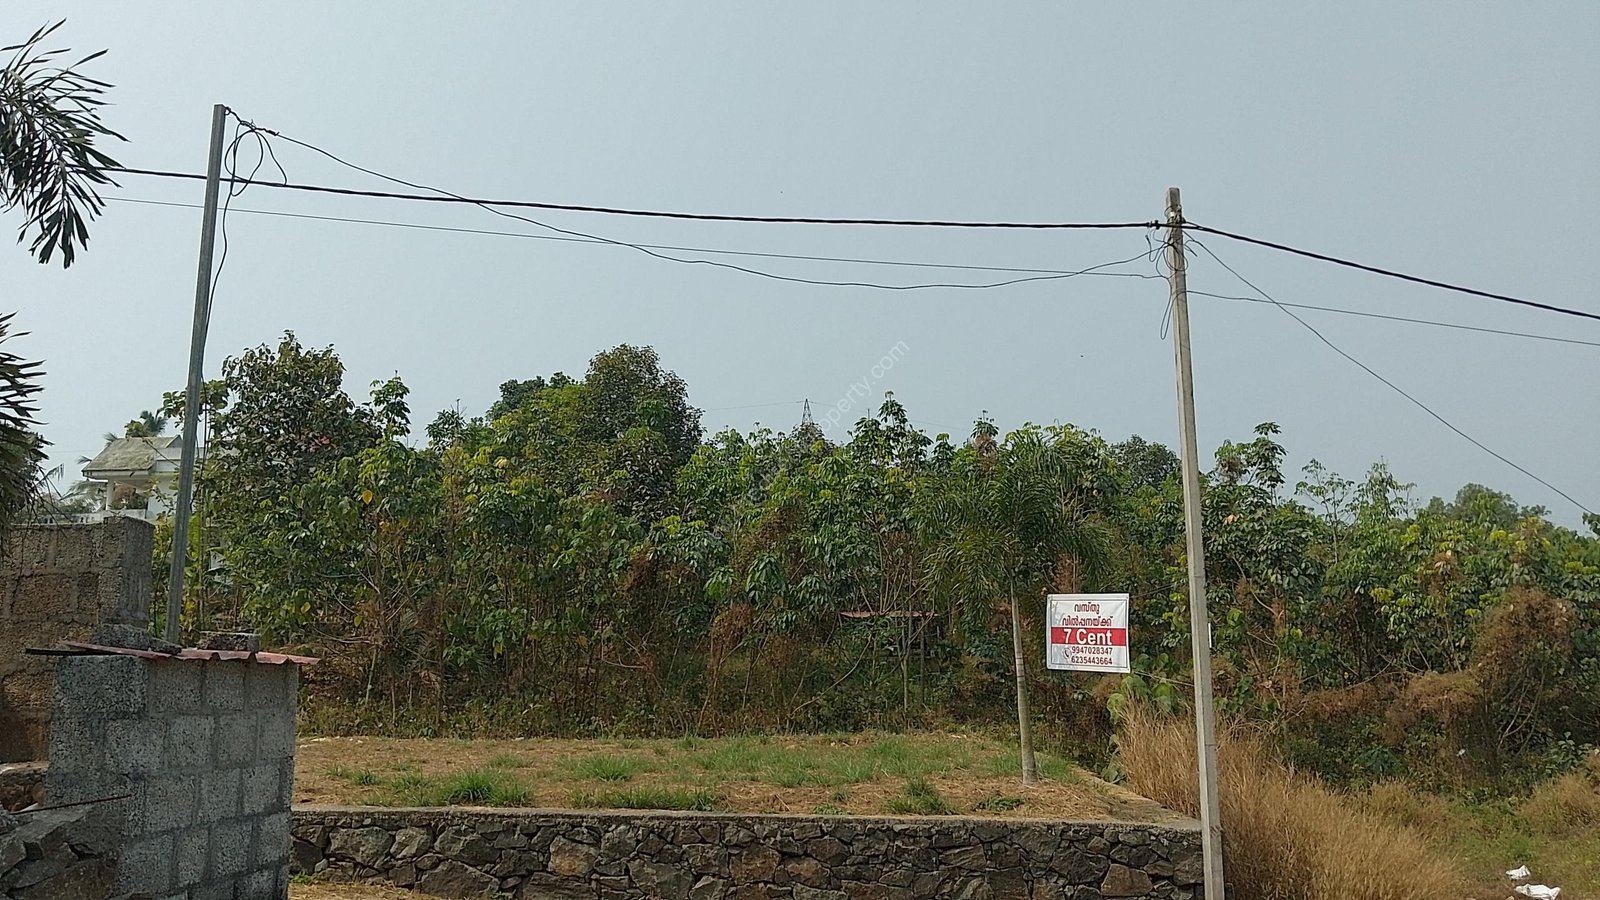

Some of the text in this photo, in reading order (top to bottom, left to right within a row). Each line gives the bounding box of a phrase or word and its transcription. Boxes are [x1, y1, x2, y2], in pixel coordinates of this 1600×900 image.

[1074, 602, 1100, 614] വസ്തു
[1063, 628, 1112, 645] 7 Cent
[1071, 646, 1113, 655] 9947028347
[1071, 655, 1113, 665] 6235443664
